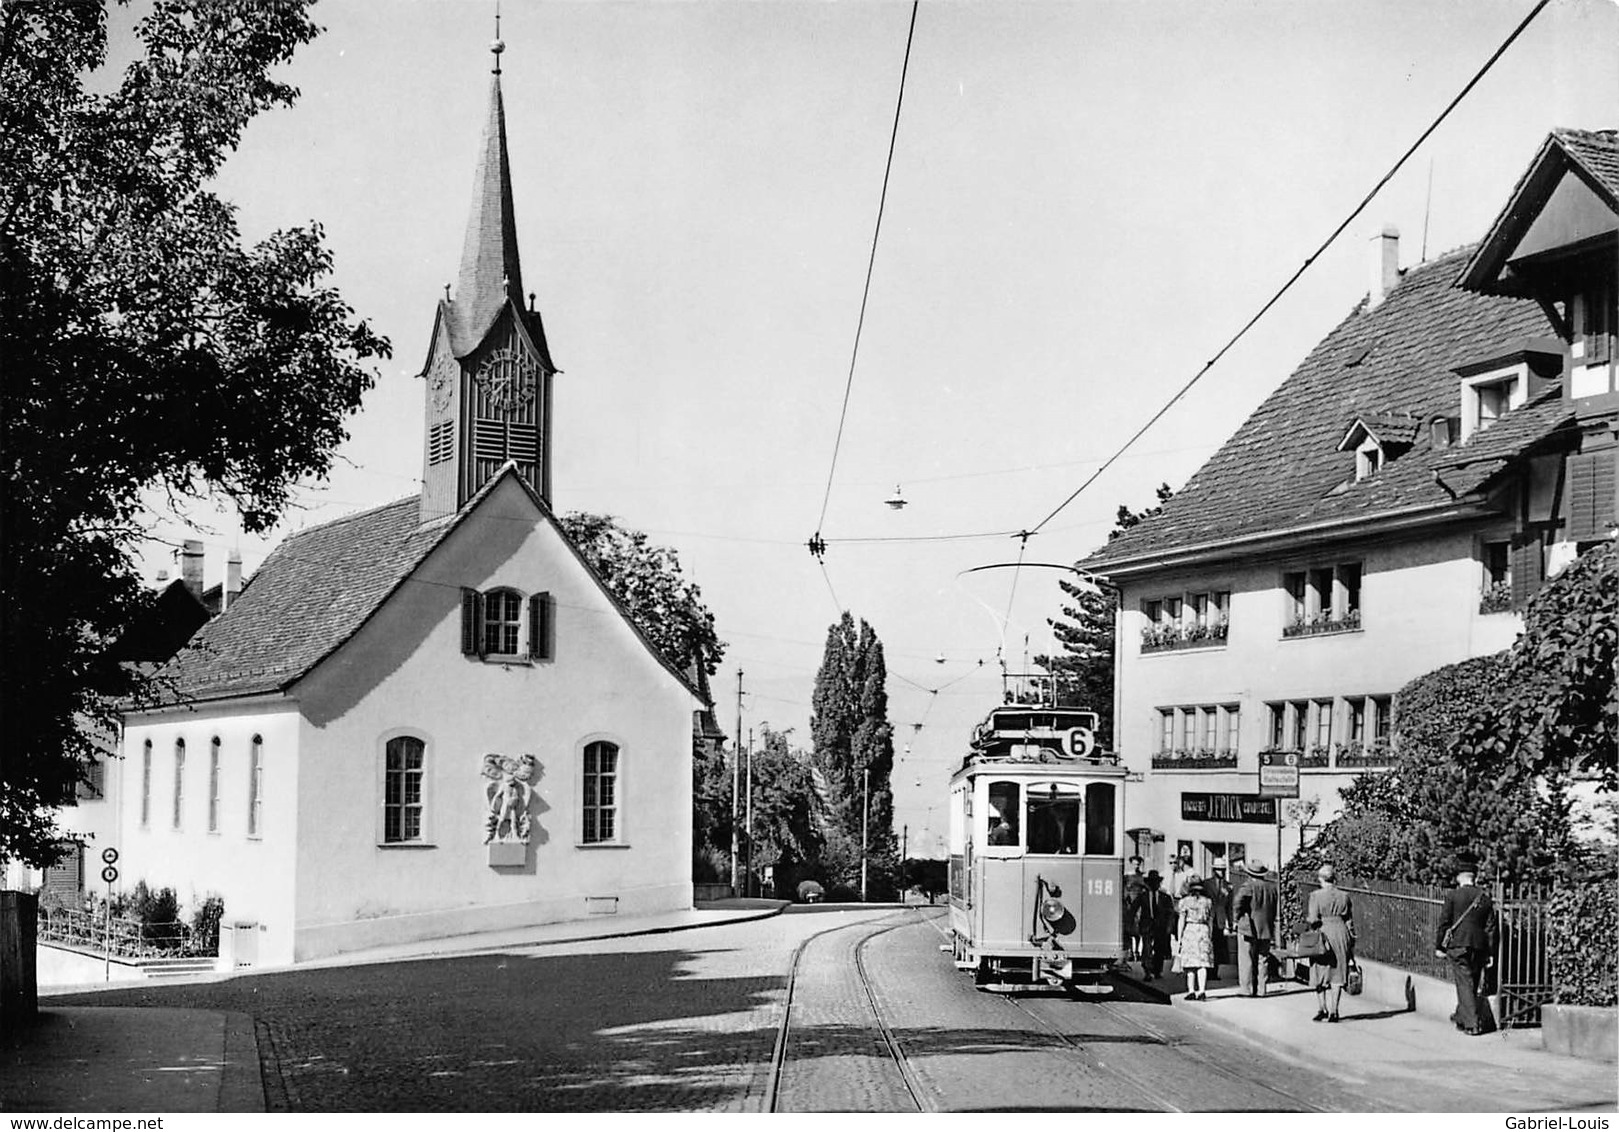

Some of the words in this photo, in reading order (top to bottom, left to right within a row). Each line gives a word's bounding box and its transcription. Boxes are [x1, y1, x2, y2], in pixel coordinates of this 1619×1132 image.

[1071, 730, 1086, 755] 6
[1264, 755, 1270, 765] 5
[1288, 755, 1295, 764] 6
[1087, 880, 1113, 895] 198
